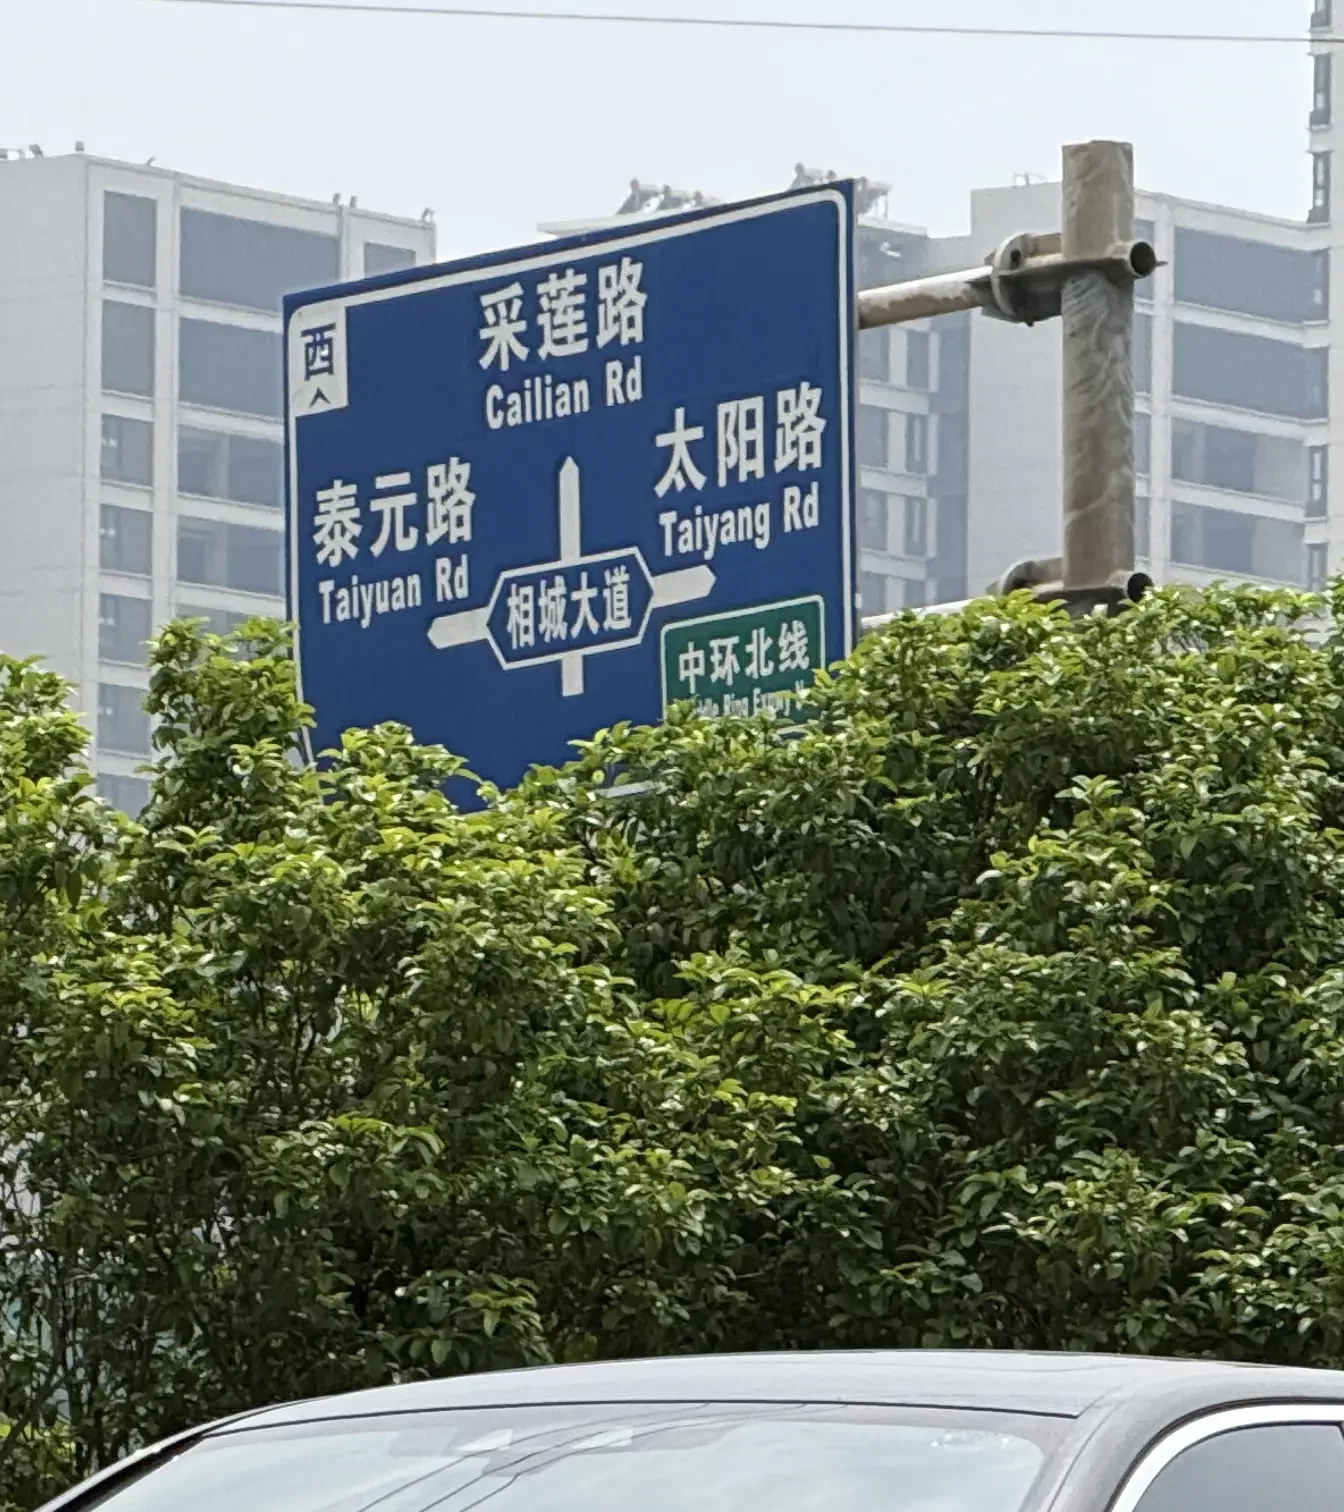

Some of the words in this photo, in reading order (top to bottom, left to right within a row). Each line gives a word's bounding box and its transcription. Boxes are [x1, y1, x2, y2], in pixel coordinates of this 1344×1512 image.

[300, 322, 337, 382] 西
[478, 257, 647, 372] 采莲路
[486, 373, 590, 429] Cailian
[605, 355, 644, 407] Rd
[654, 381, 828, 499] 太阳路
[313, 456, 477, 568] 泰元路
[659, 499, 771, 560] Taiyang
[783, 481, 820, 534] Rd
[319, 573, 422, 629] Taiyuan
[435, 553, 469, 602] Rd
[506, 565, 633, 651] 相城大道
[679, 620, 810, 694] 中环北线
